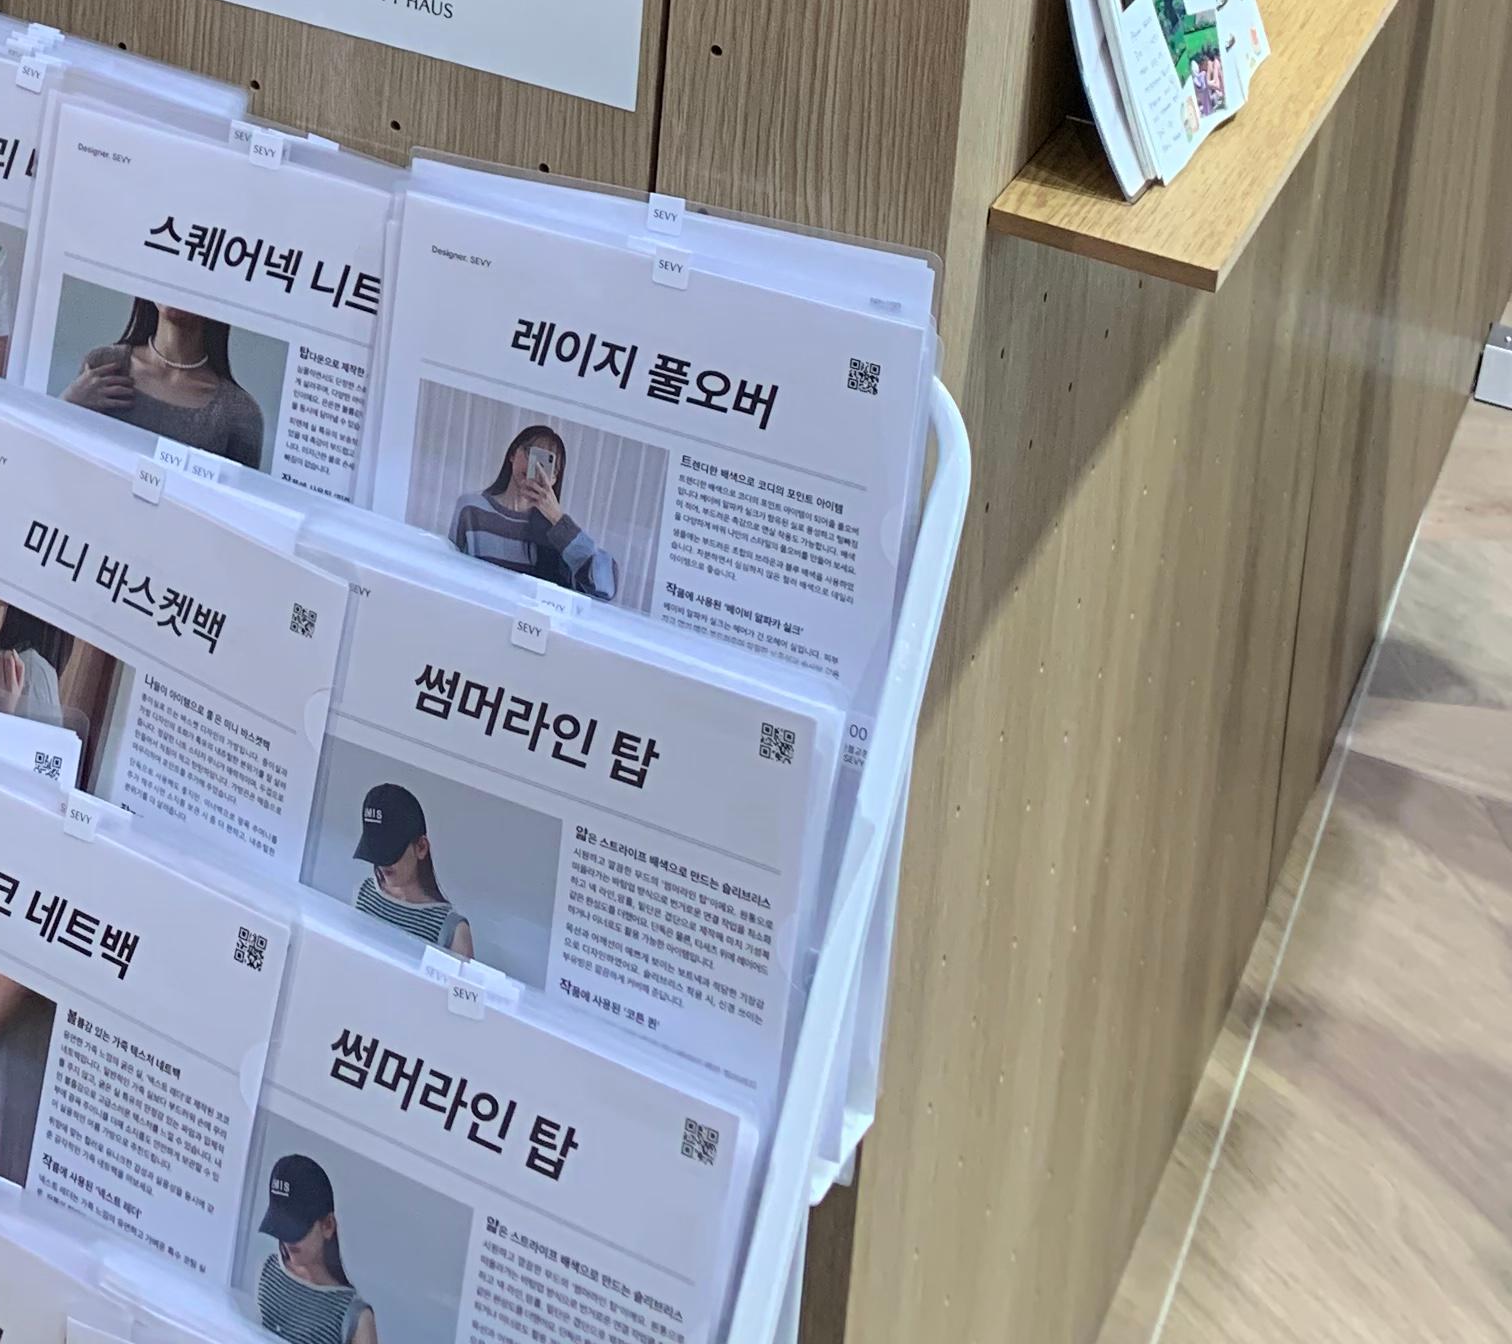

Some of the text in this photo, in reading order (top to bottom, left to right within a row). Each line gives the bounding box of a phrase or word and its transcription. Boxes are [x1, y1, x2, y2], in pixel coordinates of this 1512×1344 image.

[22, 65, 40, 79] SEVY
[253, 143, 276, 158] SEVY
[654, 208, 678, 222] SEVY
[144, 215, 381, 316] 스퀘어넥 니트
[469, 255, 492, 267] SEVY
[659, 259, 683, 274] SEVY
[511, 318, 779, 429] 레이지 풀오버
[159, 450, 182, 467] SEVY
[138, 470, 160, 487] SEVY
[191, 465, 215, 481] SEVY
[757, 479, 785, 497] 코디의
[23, 520, 227, 653] 미니 바스켓백
[517, 621, 543, 637] SEVY
[415, 664, 660, 789] 썸머라인 탑
[70, 807, 92, 824] SEVY
[599, 837, 647, 863] 스트라이프
[25, 890, 140, 980] 네트백
[453, 986, 478, 1002] SEVY
[330, 1028, 579, 1181] 썸머라인 탑
